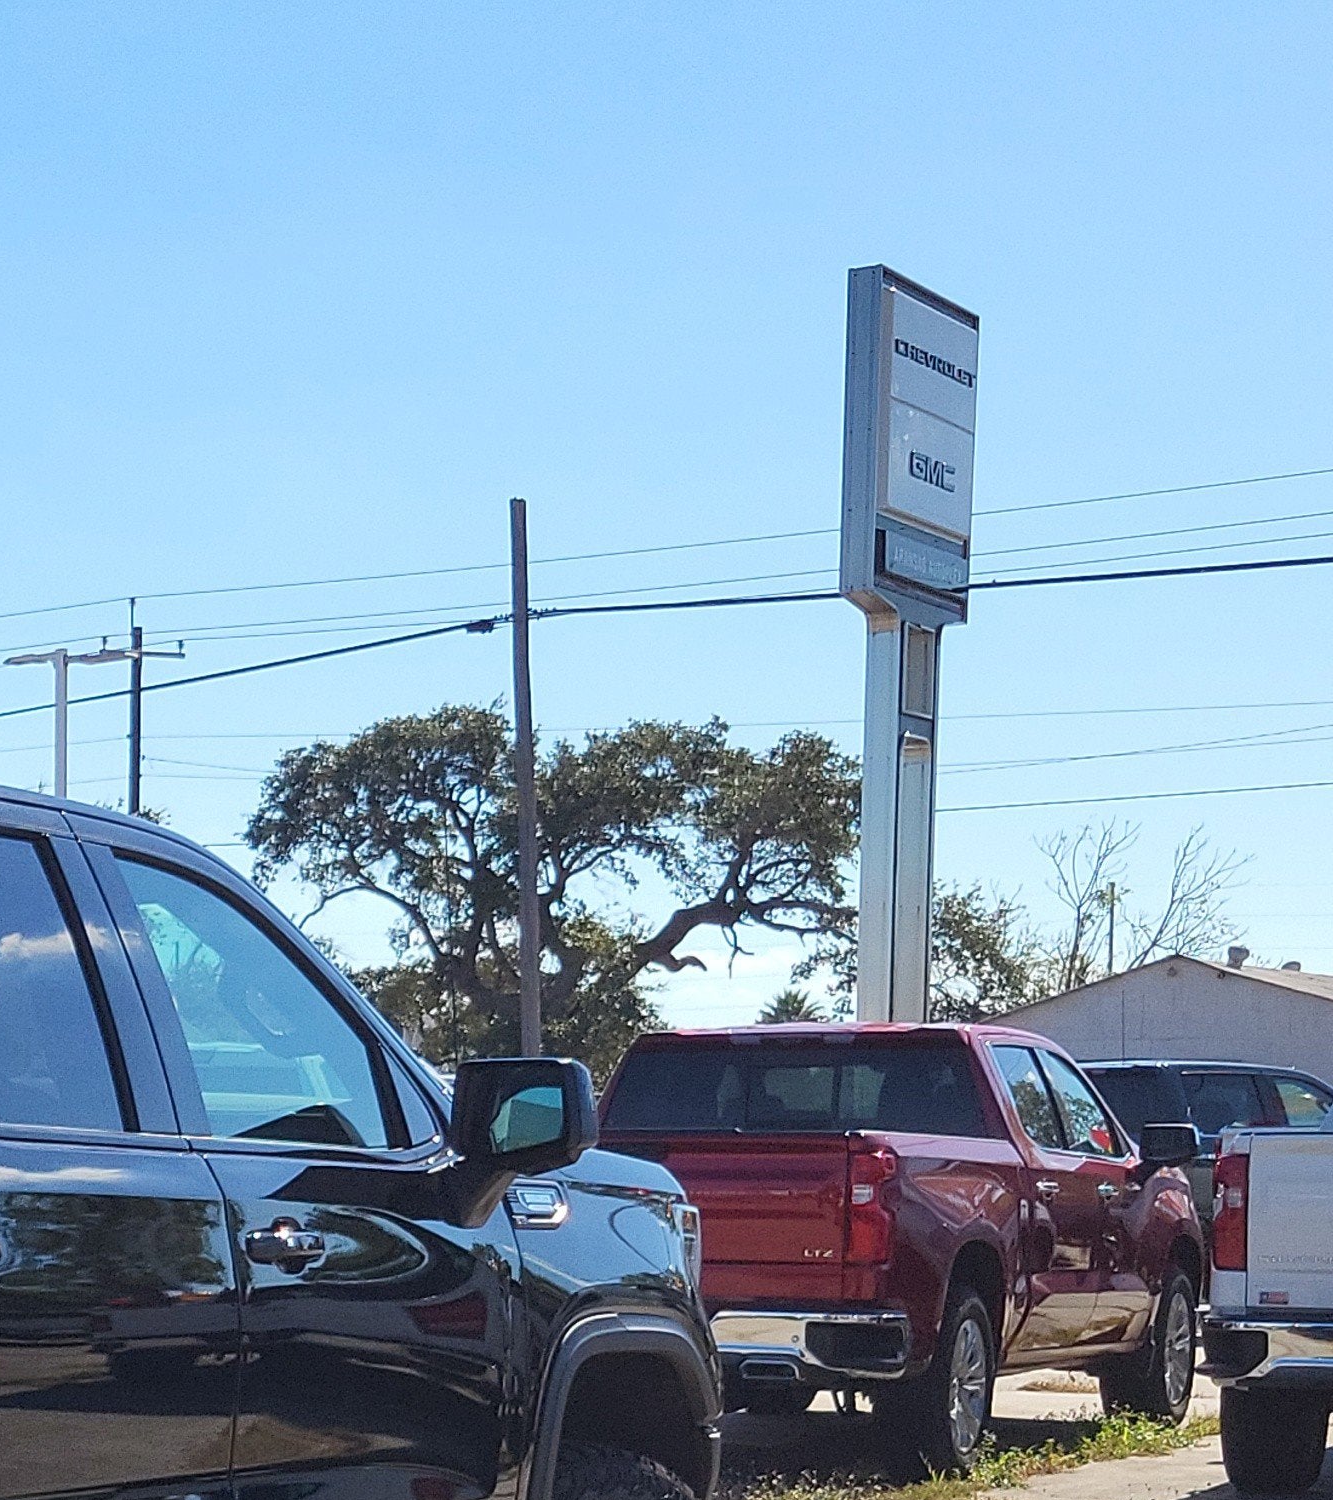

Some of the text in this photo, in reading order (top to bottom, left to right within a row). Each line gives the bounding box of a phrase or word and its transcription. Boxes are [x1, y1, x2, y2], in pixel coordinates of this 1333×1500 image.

[894, 338, 976, 388] CHEVROLET
[909, 450, 956, 493] GMC
[804, 1248, 833, 1259] LTZ
